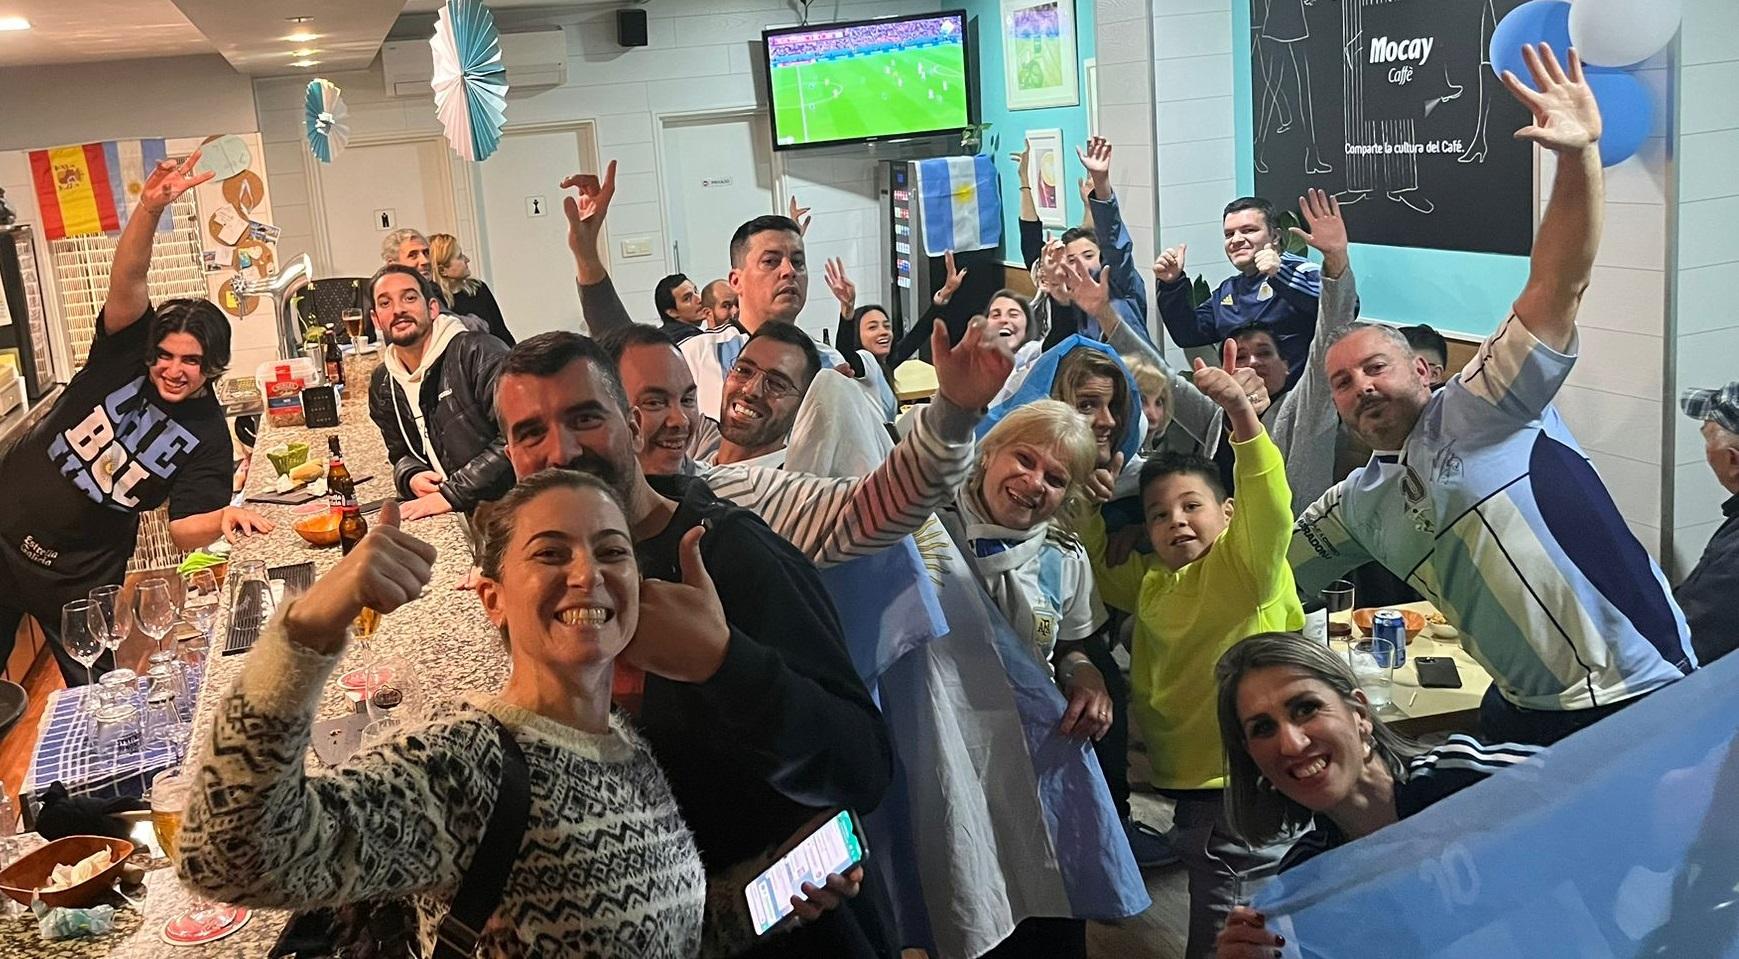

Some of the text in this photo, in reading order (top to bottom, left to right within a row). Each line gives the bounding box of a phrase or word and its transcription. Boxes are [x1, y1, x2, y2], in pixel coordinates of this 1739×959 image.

[1369, 36, 1434, 66] Mocay
[1388, 65, 1414, 85] Caffè
[1344, 139, 1465, 158] Comparte la cultura del Café.
[64, 403, 151, 508] BOL
[19, 543, 52, 567] Galicia
[24, 535, 59, 559] Estrella
